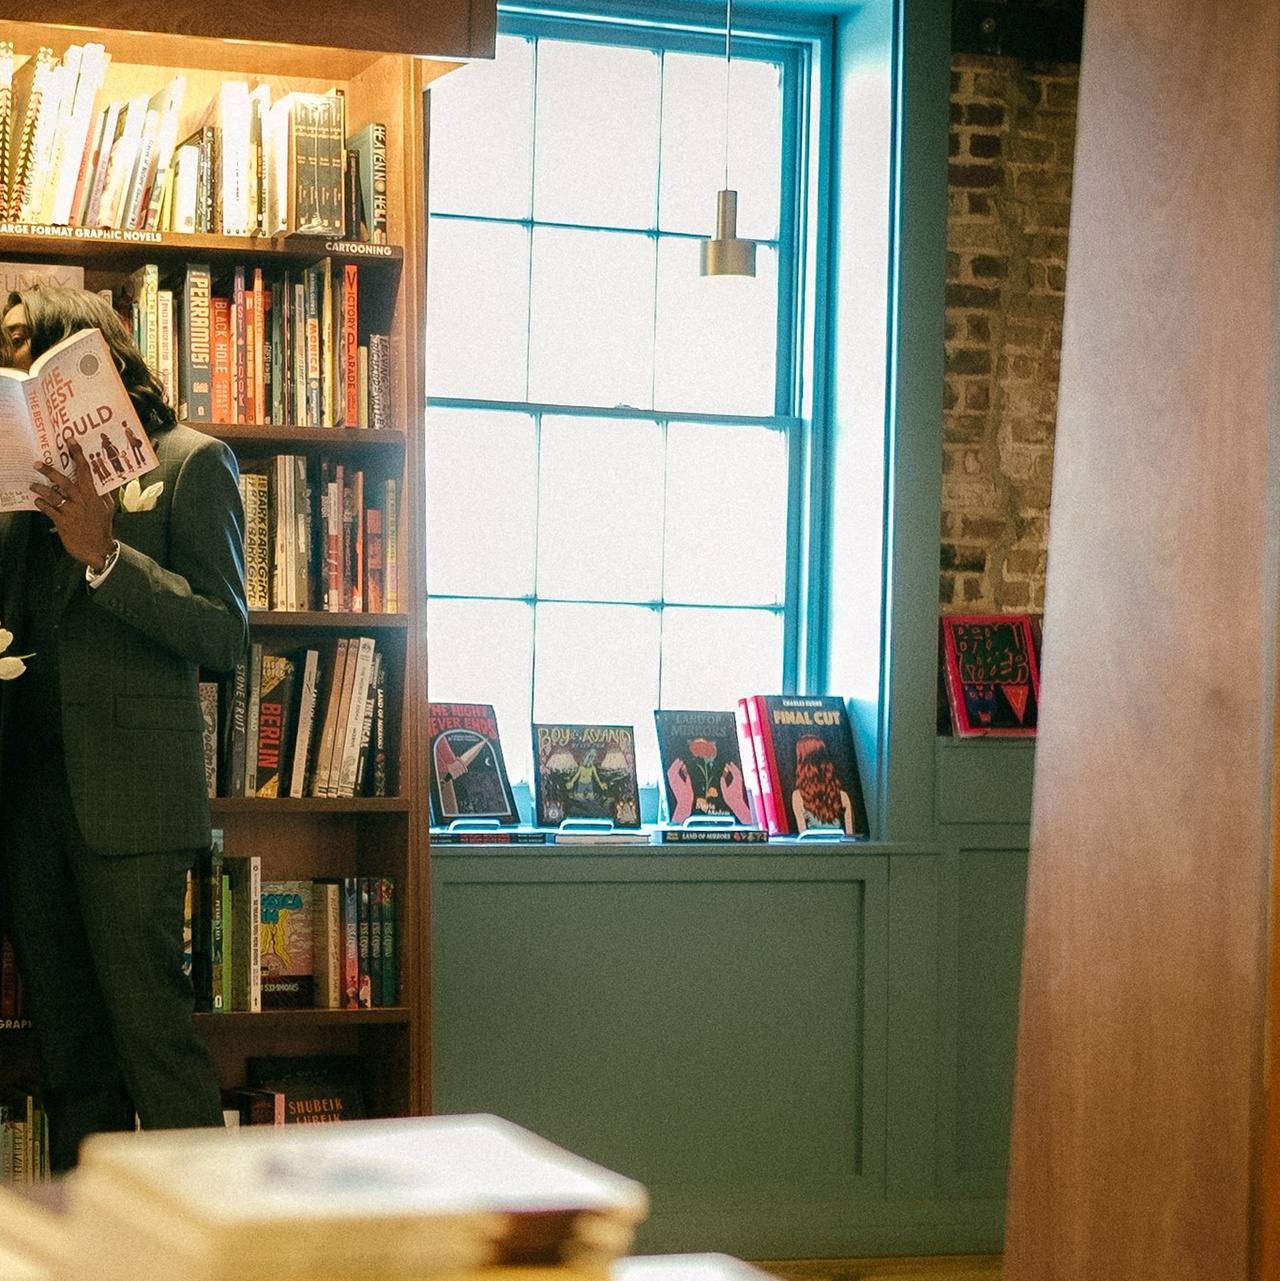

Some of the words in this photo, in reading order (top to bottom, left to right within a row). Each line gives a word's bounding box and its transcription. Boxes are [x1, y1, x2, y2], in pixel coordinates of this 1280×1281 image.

[374, 126, 386, 169] HEAVEN
[374, 194, 386, 225] HELL
[31, 227, 73, 237] FORMAT
[75, 230, 122, 240] GRAPHIC
[124, 232, 162, 242] NOVELS
[326, 242, 392, 256] CARTOONING
[236, 277, 244, 332] LAST
[346, 271, 357, 329] VICTORY
[190, 277, 210, 364] PERRAMUS
[215, 302, 228, 337] BLACK
[215, 343, 228, 374] HOLE
[347, 331, 356, 389] PARADE
[371, 342, 383, 393] RICHARD'S
[380, 338, 389, 383] LEAVING
[42, 366, 63, 398] THE
[29, 391, 39, 410] THE
[46, 380, 75, 417] BEST
[33, 411, 46, 433] BEST
[50, 406, 70, 433] WE
[56, 405, 113, 451] COULD
[39, 434, 51, 450] WE
[258, 489, 267, 526] BARK
[258, 527, 267, 566] BARK
[235, 664, 246, 697] STONE
[364, 698, 375, 717] THE
[377, 688, 385, 707] LAND
[452, 705, 488, 718] NIGHT
[783, 699, 803, 707] CHARLES
[235, 700, 245, 734] FRUIT
[377, 709, 384, 718] OF
[464, 717, 497, 738] ENDS
[676, 714, 706, 723] LAND
[708, 714, 721, 723] OF
[773, 710, 812, 725] FINAL
[814, 711, 841, 726] CUT
[258, 703, 282, 768] BERLIN
[360, 719, 373, 748] INCAL
[376, 718, 384, 750] MIRRORS
[538, 728, 570, 752] BOY
[671, 724, 727, 737] MIRRORS
[265, 983, 299, 992] SIMMONS
[288, 1098, 344, 1115] SHUBEIK
